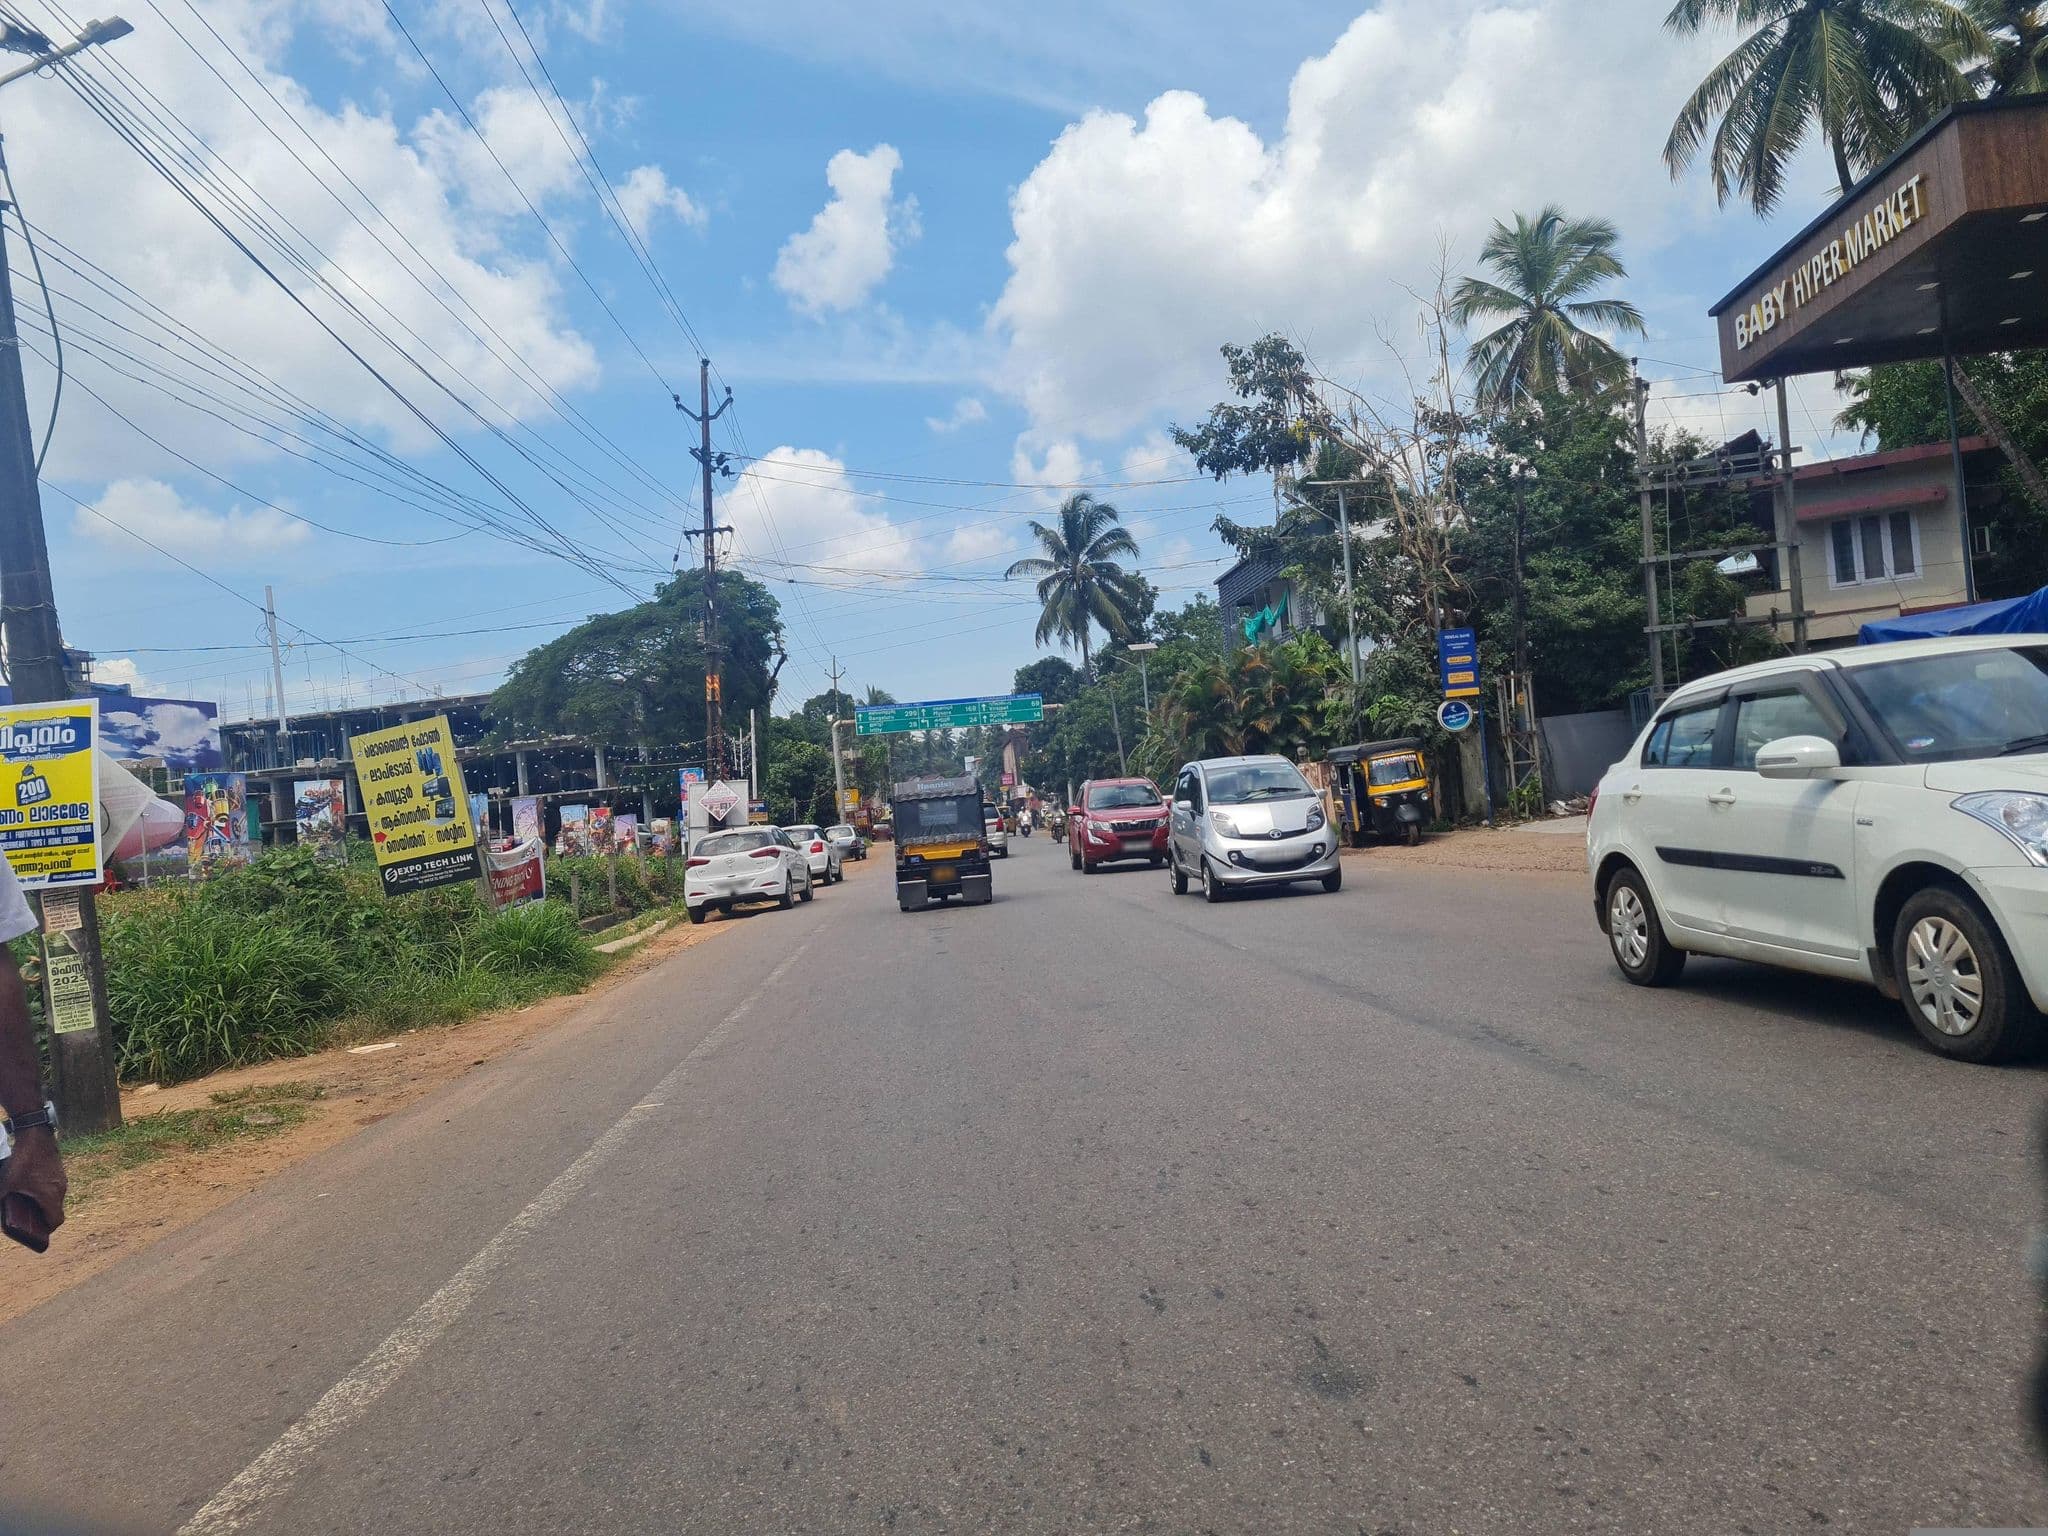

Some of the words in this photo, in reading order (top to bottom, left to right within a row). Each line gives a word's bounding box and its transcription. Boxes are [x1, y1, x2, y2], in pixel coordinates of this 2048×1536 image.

[1734, 280, 1789, 351] BABY
[1791, 238, 1849, 308] HYPER
[1844, 174, 1926, 270] MARKET
[19, 778, 47, 799] 200
[398, 863, 422, 876] EXPO
[424, 857, 449, 870] TECH
[451, 853, 474, 865] LINK
[53, 974, 88, 986] 2023
